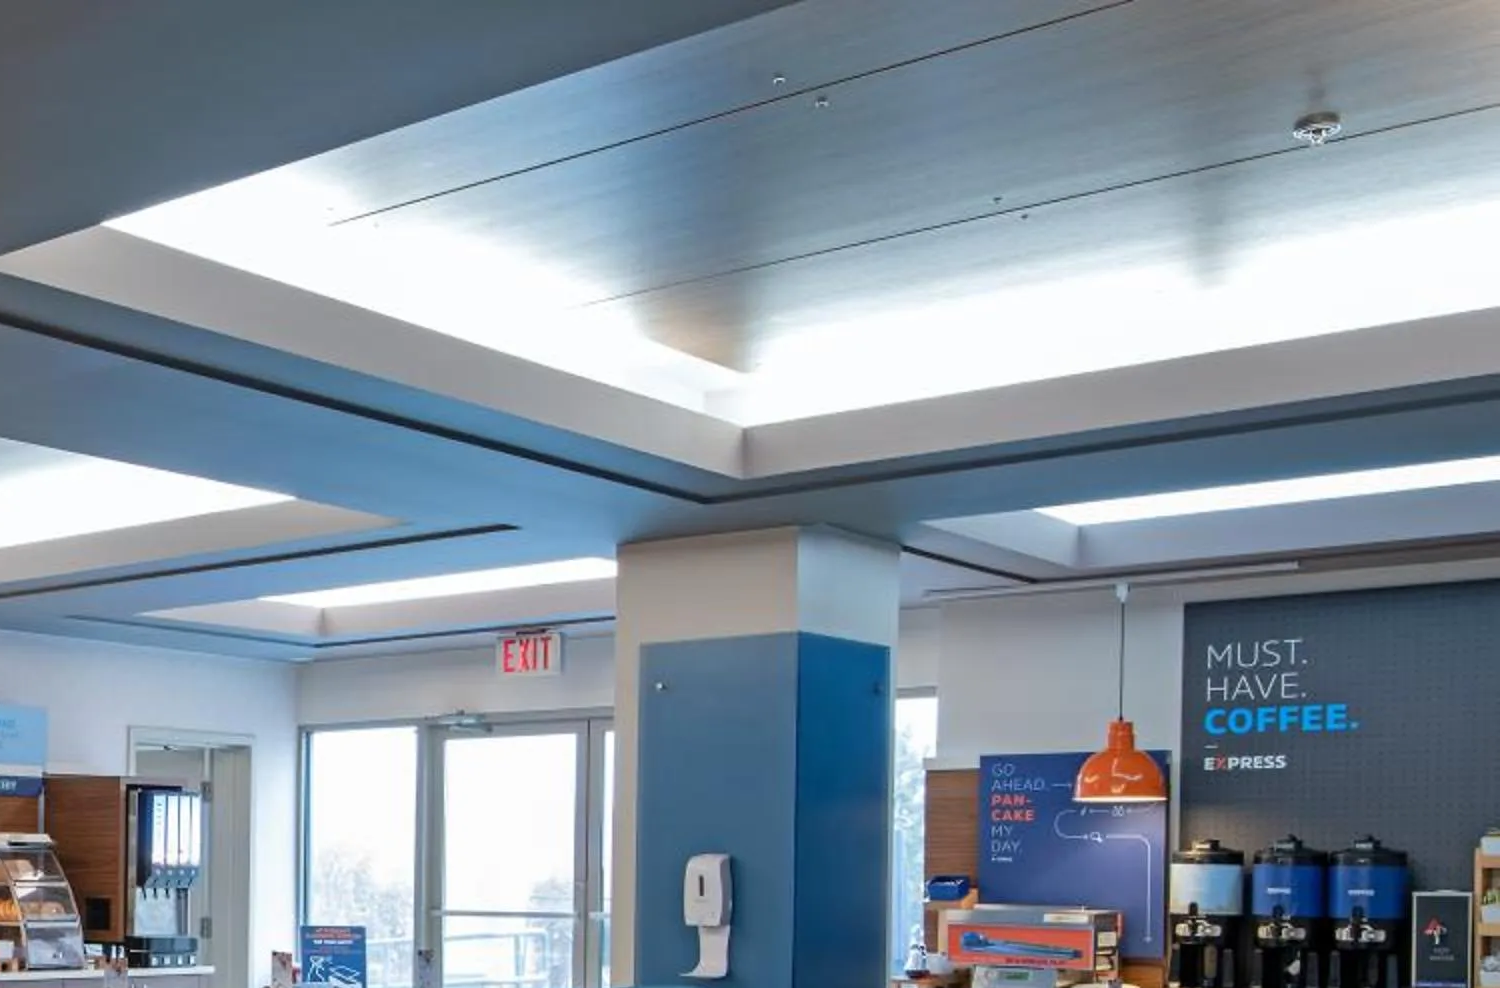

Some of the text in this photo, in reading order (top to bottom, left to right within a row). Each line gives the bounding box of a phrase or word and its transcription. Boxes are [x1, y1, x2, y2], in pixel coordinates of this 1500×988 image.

[503, 636, 552, 672] EXIT
[1206, 639, 1308, 669] MUST.
[1206, 672, 1307, 702] HAVE.
[1204, 704, 1359, 735] COFFEE.
[991, 763, 1015, 777] GO
[1203, 755, 1288, 771] EXPRESS
[991, 794, 1032, 806] PAN-
[991, 809, 1035, 822] CAKE
[991, 825, 1013, 838] MY
